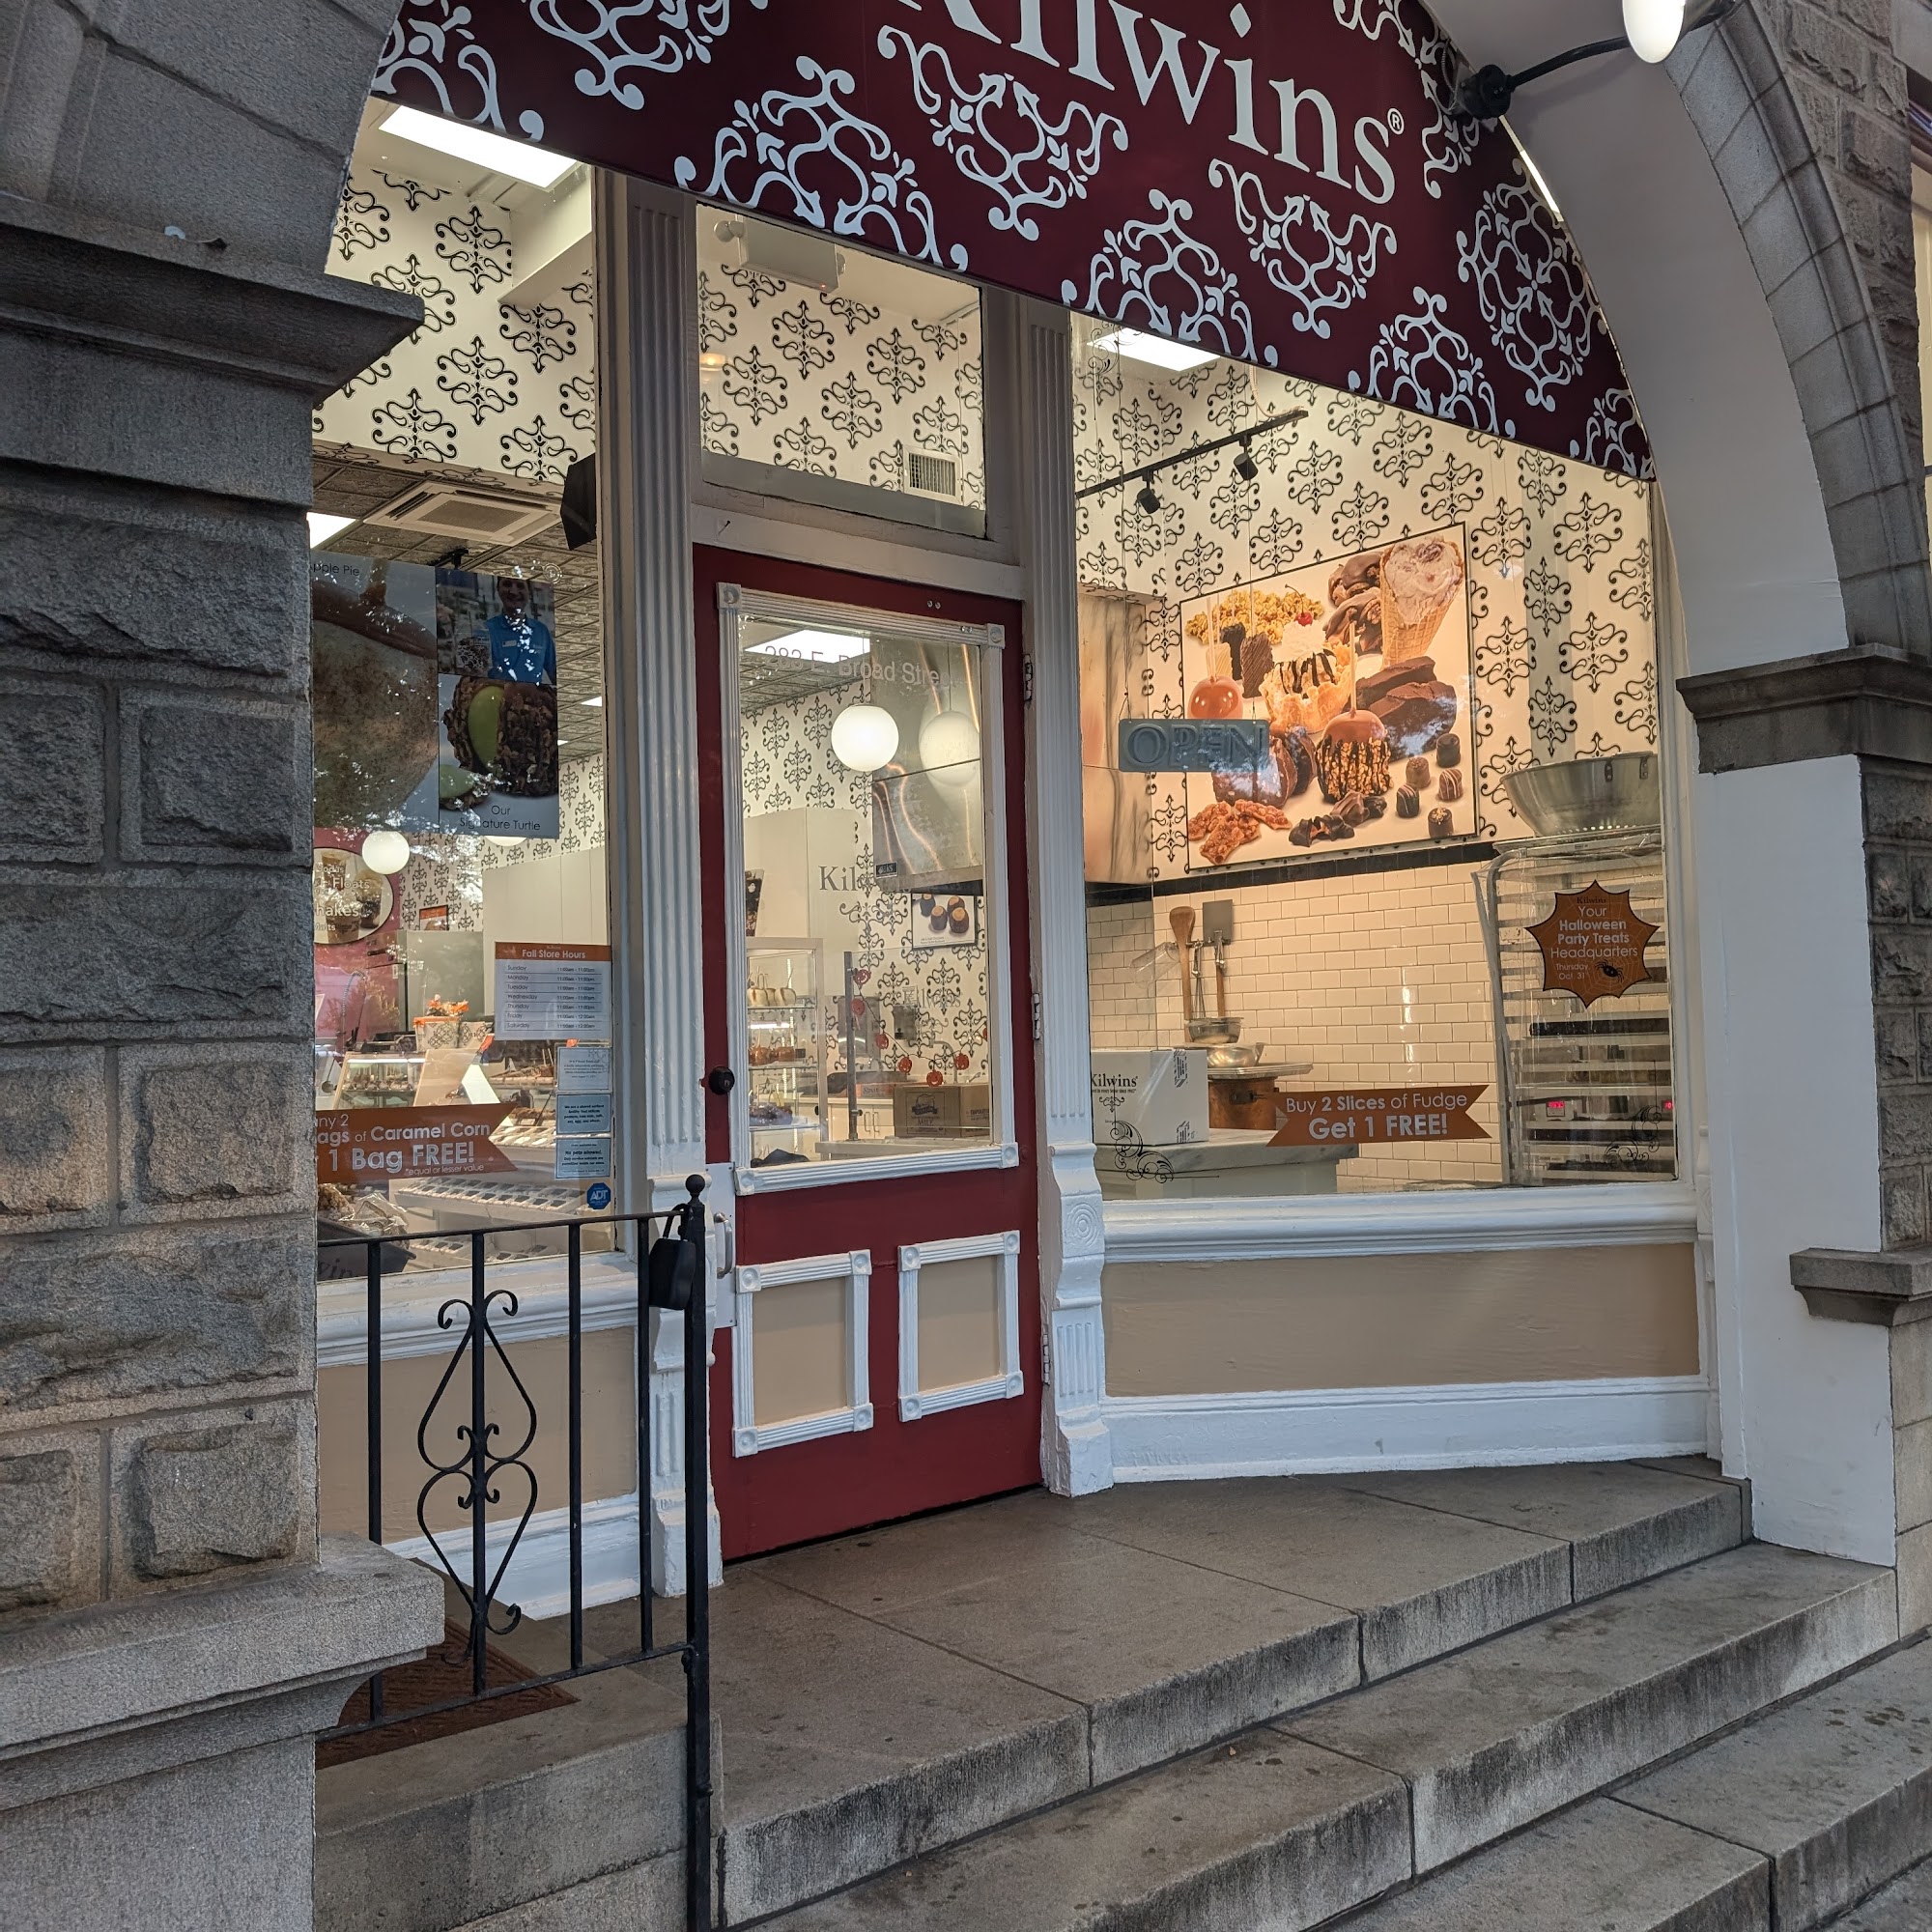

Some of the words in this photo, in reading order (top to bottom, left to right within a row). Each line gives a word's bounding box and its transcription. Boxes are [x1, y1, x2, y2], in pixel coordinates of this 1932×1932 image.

[343, 564, 360, 577] Pie
[765, 645, 804, 670] 283
[811, 651, 830, 673] E.
[838, 654, 895, 681] Broad
[1125, 723, 1266, 768] OPEN
[491, 805, 511, 815] Our
[459, 817, 511, 830] Sigature
[513, 819, 541, 831] Turtle
[332, 876, 371, 889] Floats
[315, 902, 360, 918] hakes
[1577, 906, 1607, 917] Your
[1559, 919, 1627, 931] Halloween
[1557, 934, 1589, 946] Party
[1593, 933, 1630, 944] Treats
[522, 949, 537, 958] Fall
[539, 950, 560, 958] Store
[562, 951, 586, 959] Hours
[1550, 945, 1638, 959] Headquarters
[1286, 1097, 1318, 1115] Buy
[1321, 1096, 1332, 1112] 2
[1337, 1095, 1386, 1111] Slices
[1390, 1094, 1408, 1109] of
[1413, 1093, 1467, 1111] Fudge
[340, 1114, 350, 1127] 2
[1308, 1116, 1356, 1140] Get
[1365, 1116, 1375, 1138] 1
[1386, 1113, 1448, 1137] FREE!
[315, 1130, 351, 1147] ags
[355, 1131, 367, 1142] of
[370, 1122, 446, 1142] Caramel
[450, 1122, 491, 1138] Corn
[328, 1150, 338, 1172] 1
[352, 1148, 403, 1174] Bag
[412, 1141, 474, 1167] FREE!
[463, 1163, 485, 1172] value
[589, 1189, 609, 1201] ADT
